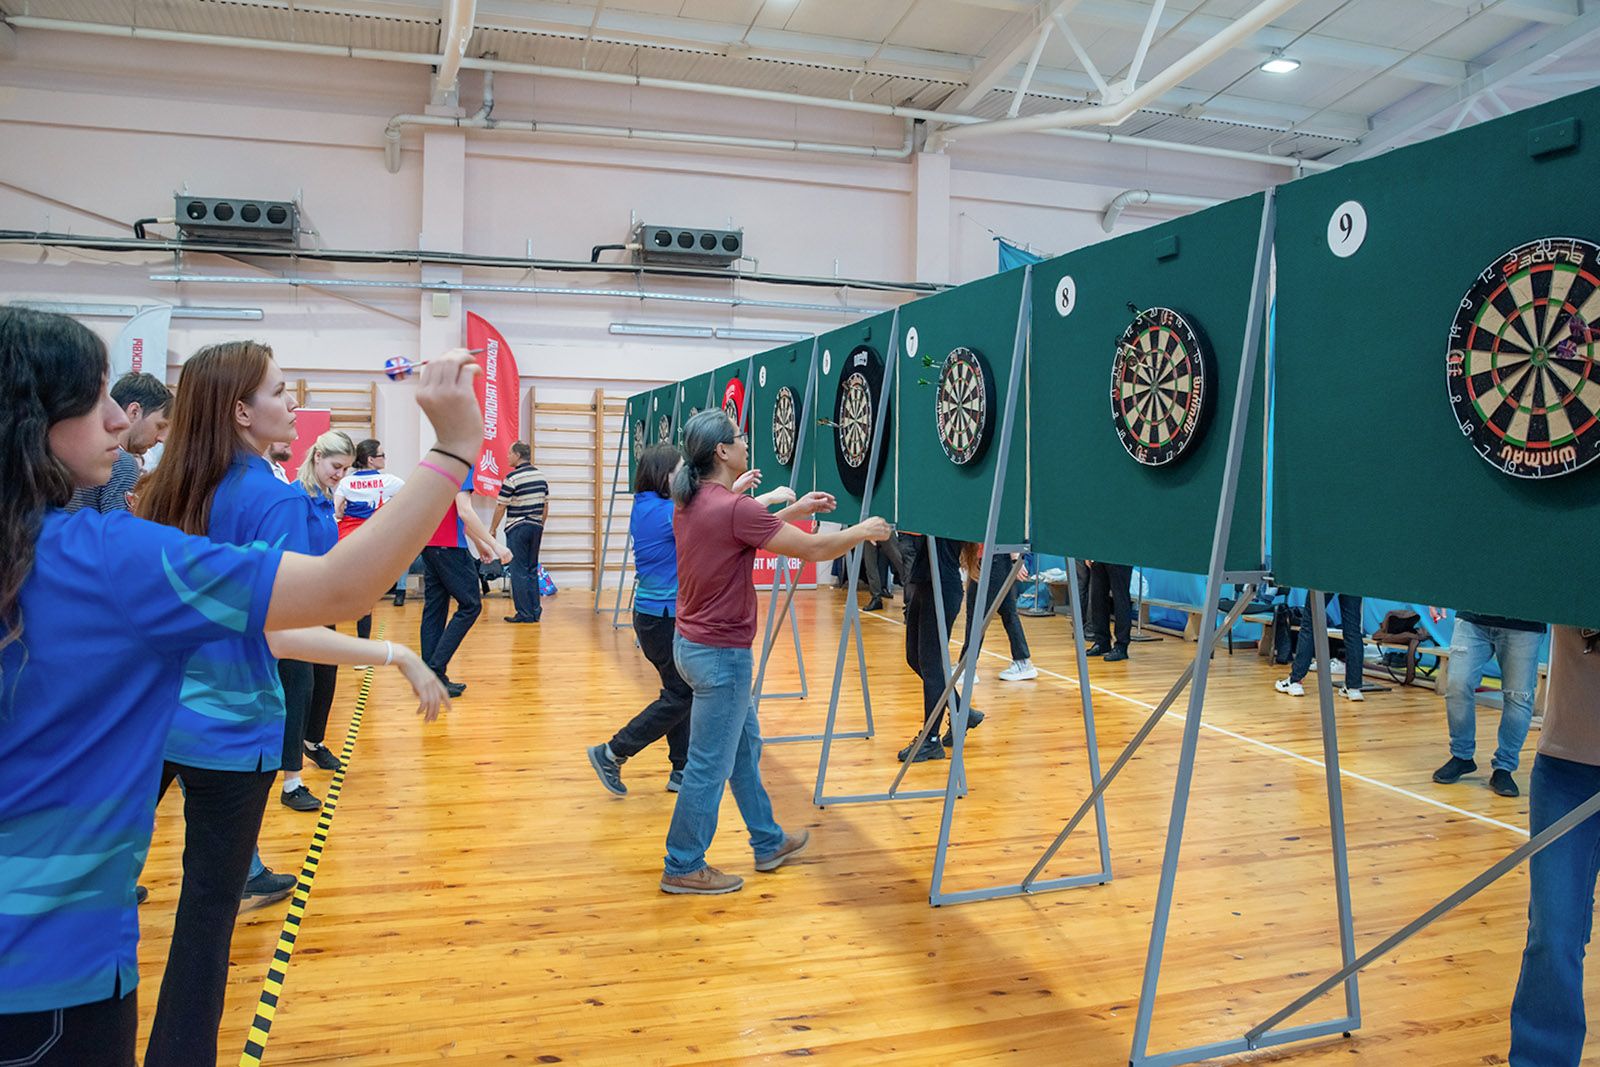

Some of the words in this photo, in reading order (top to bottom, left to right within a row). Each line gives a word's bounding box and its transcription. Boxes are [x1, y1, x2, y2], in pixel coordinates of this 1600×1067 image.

[1340, 213, 1353, 243] 9
[1062, 287, 1069, 308] 8
[486, 338, 498, 381] МОСКВЫ
[484, 382, 497, 440] ЧЕМПИОНАТ
[1500, 445, 1577, 467] WINMAU
[350, 479, 384, 489] МОСКВА
